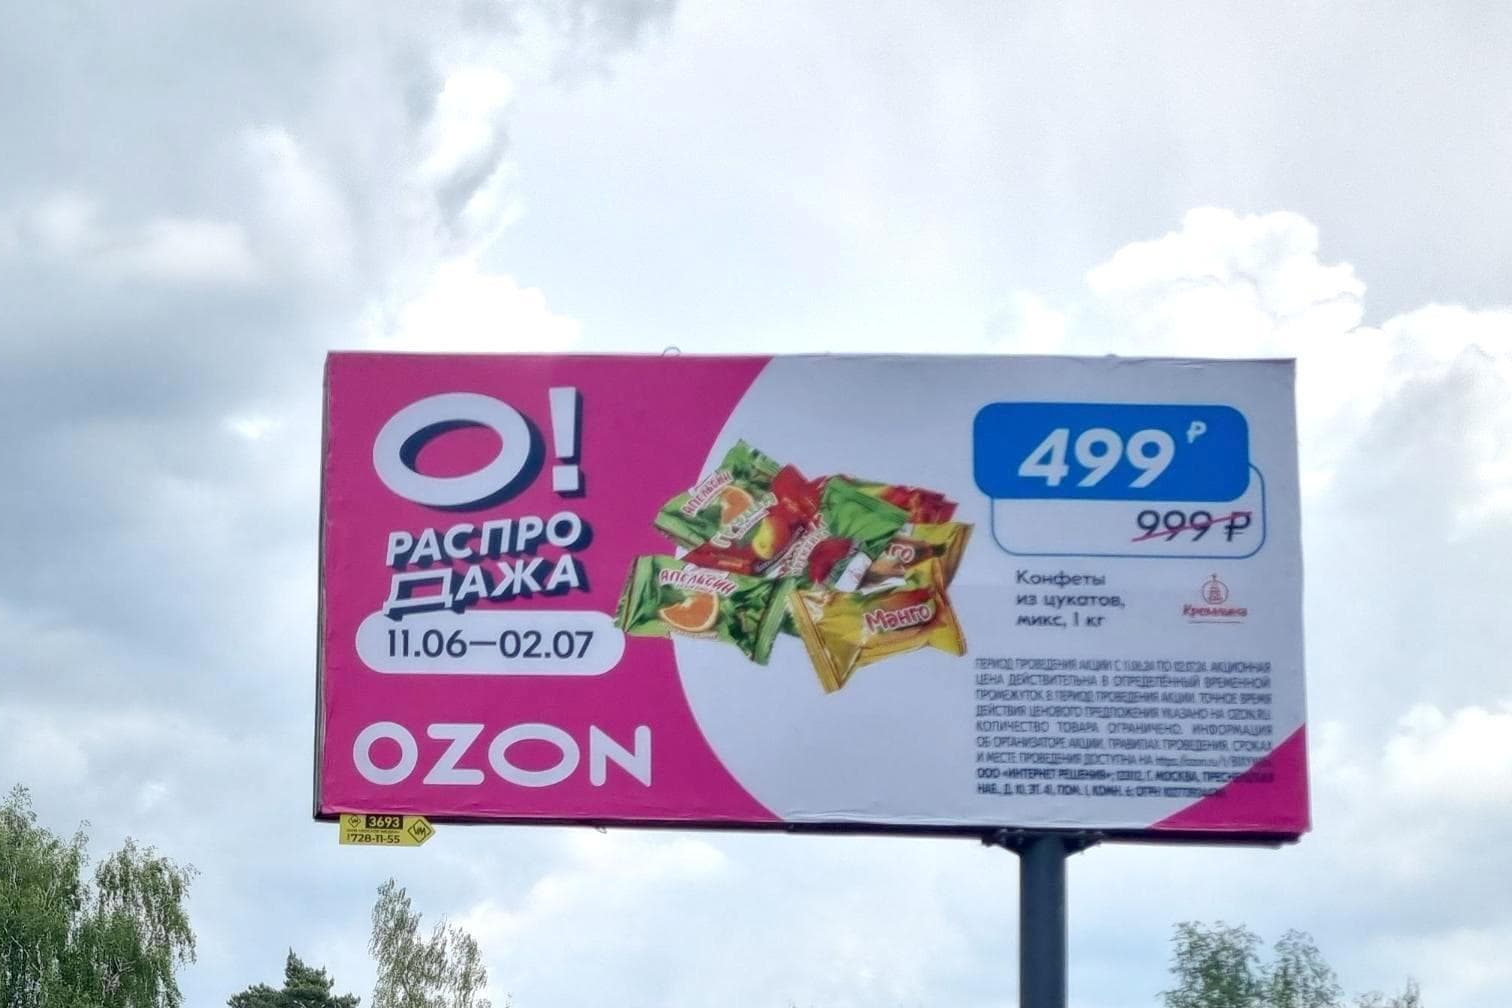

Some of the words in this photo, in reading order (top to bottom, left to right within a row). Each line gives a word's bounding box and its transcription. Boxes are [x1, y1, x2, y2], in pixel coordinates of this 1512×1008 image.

[1018, 427, 1176, 488] 499
[386, 511, 586, 568] РАСПРО
[1136, 510, 1213, 542] 999
[383, 554, 583, 618] ДАЖА
[660, 569, 738, 595] АПЕЛЬСИН
[1016, 570, 1105, 587] Конфеты
[1016, 596, 1037, 606] из
[1044, 594, 1125, 609] цукатов,
[865, 604, 932, 633] Манго
[1016, 615, 1067, 628] микс,
[1087, 615, 1106, 628] кг
[352, 720, 652, 788] OZON
[368, 816, 401, 828] 3693
